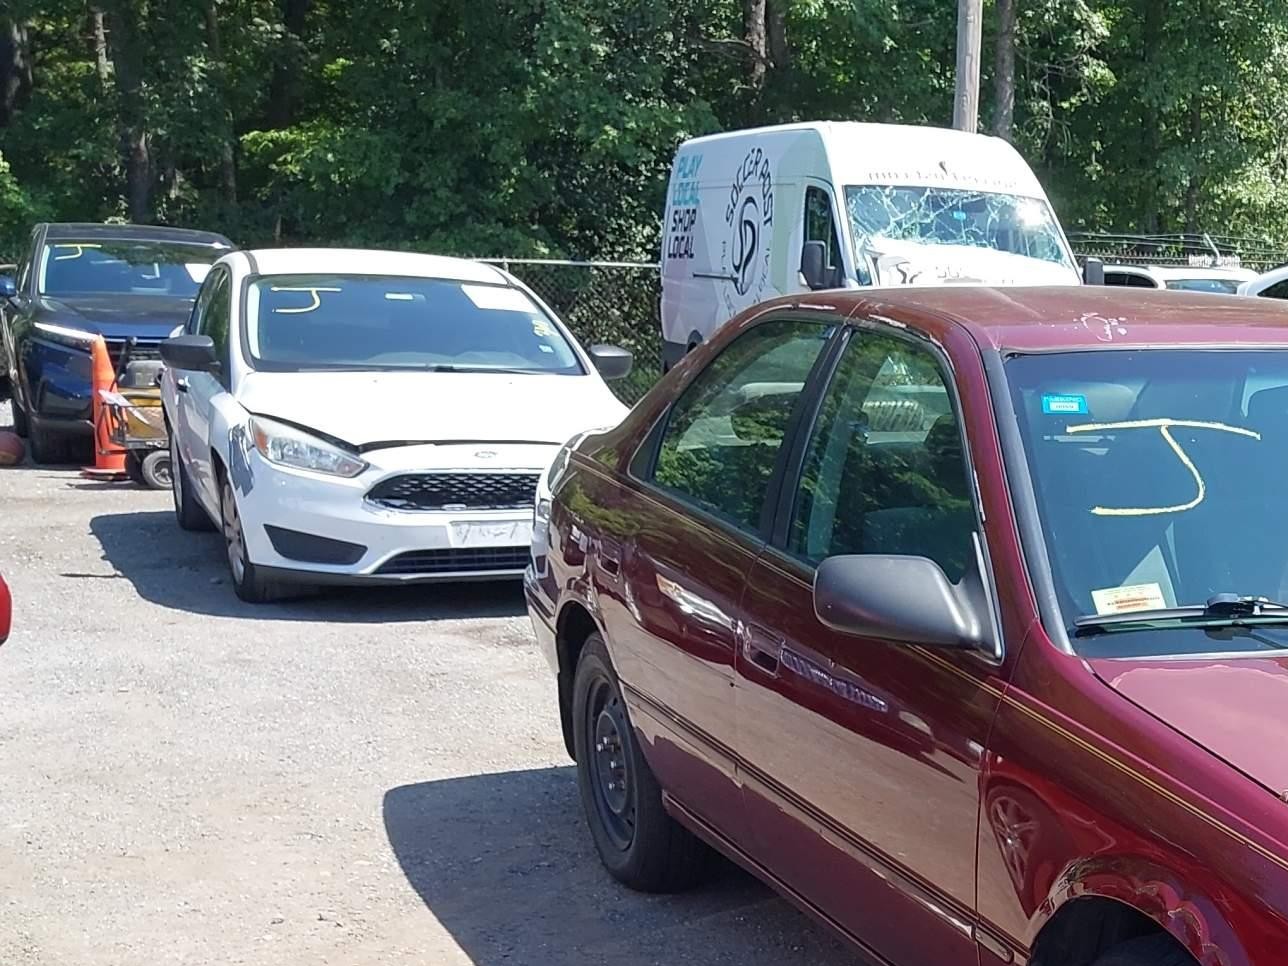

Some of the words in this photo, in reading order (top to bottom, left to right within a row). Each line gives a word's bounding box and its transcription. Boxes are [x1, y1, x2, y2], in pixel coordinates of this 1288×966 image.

[676, 154, 703, 178] PLAY
[726, 148, 763, 226] SOCCER
[759, 158, 774, 227] POST
[671, 208, 697, 233] SHOP
[667, 236, 695, 259] LOCAL
